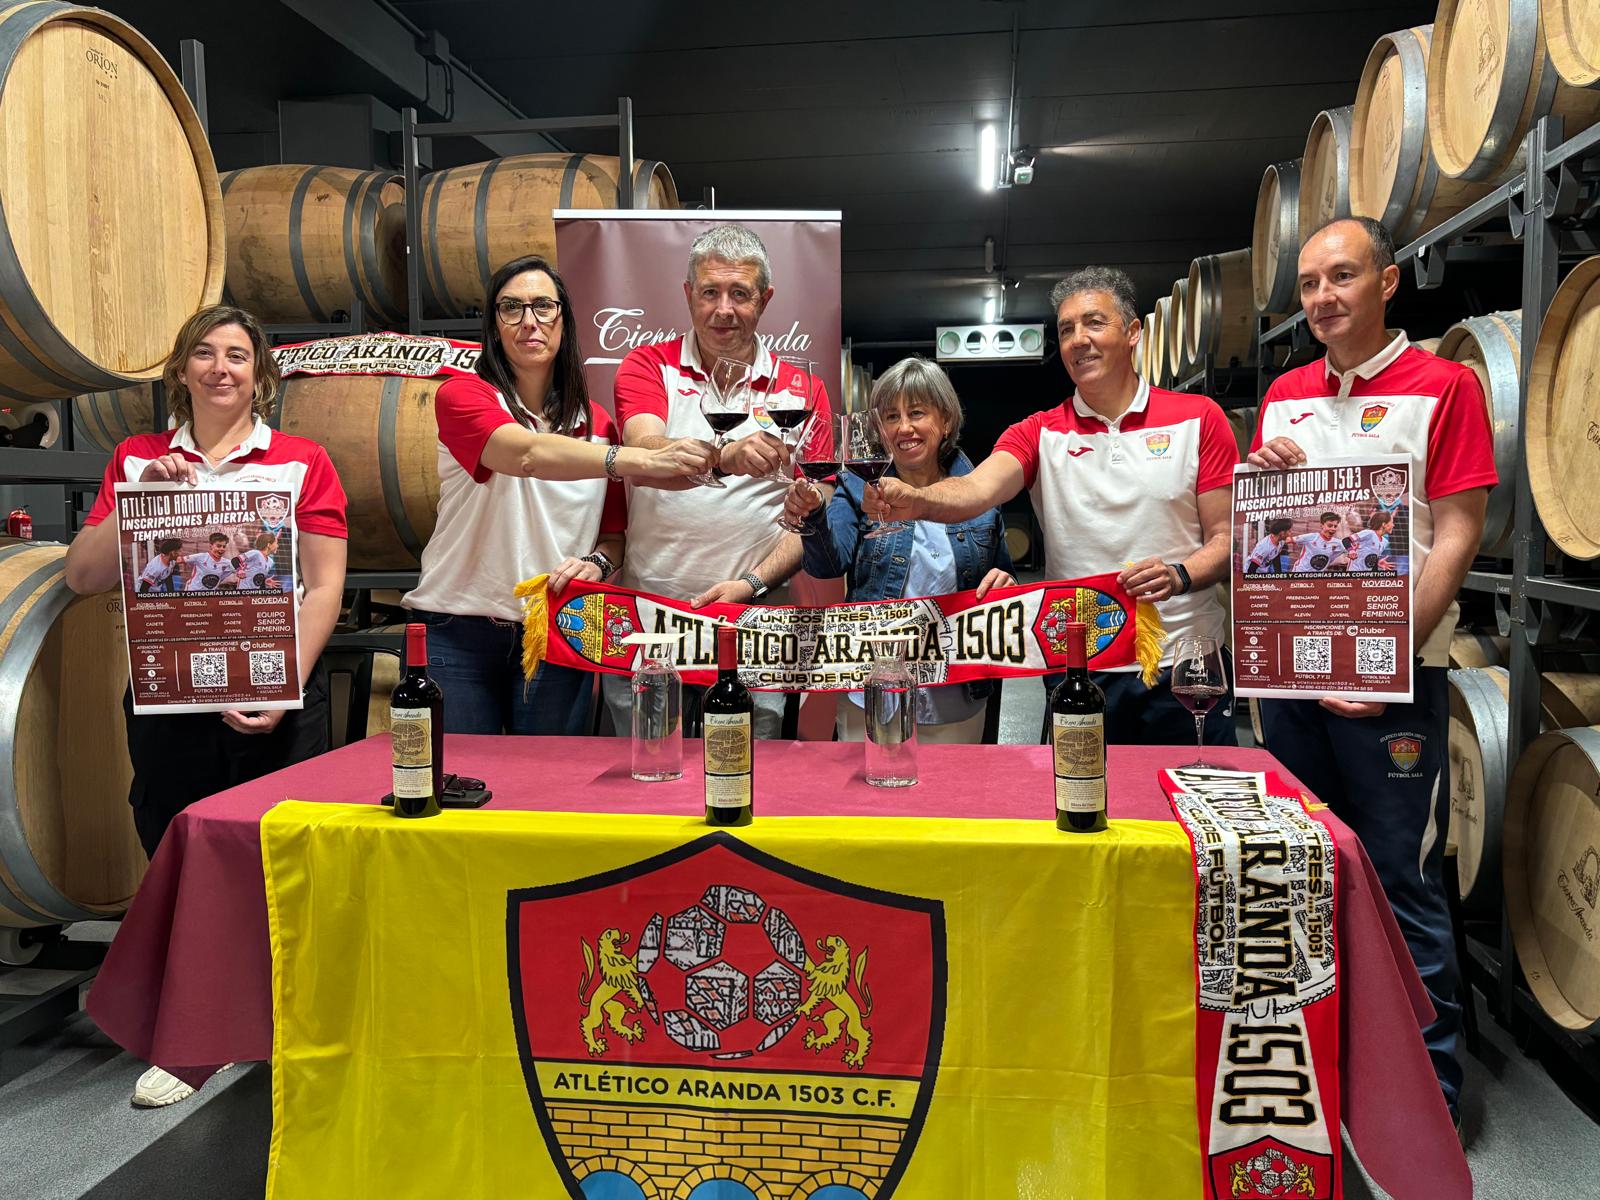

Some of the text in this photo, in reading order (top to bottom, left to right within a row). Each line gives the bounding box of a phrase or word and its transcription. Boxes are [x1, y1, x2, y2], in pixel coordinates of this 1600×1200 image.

[86, 50, 118, 75] ORION
[593, 307, 681, 352] Tierr
[343, 345, 444, 363] ARANDA
[452, 349, 483, 370] 15
[1237, 472, 1283, 500] ATLÉTICO
[1286, 470, 1329, 494] ARANDA
[122, 492, 171, 518] ATLÉTICO
[174, 493, 216, 515] ARANDA
[1236, 488, 1371, 512] INSCRIPCIONES ABIERTAS
[122, 510, 256, 531] INSCRIPCIONES ABIERTAS
[1366, 595, 1399, 603] EQUIPO
[256, 611, 286, 619] EQUIPO
[257, 618, 286, 626] SENIOR
[1361, 610, 1405, 618] FEMENINO
[956, 599, 1026, 665] 1503
[1359, 626, 1386, 634] cluber
[759, 672, 809, 684] CLUB
[811, 672, 837, 684] DE
[1202, 826, 1222, 845] DE
[1208, 848, 1228, 961] FÚTBOL
[1232, 825, 1301, 1007] ARANDA
[1219, 1022, 1317, 1127] 1503
[554, 1070, 896, 1108] ATLÉTICO ARANDA 1503 C.F.
